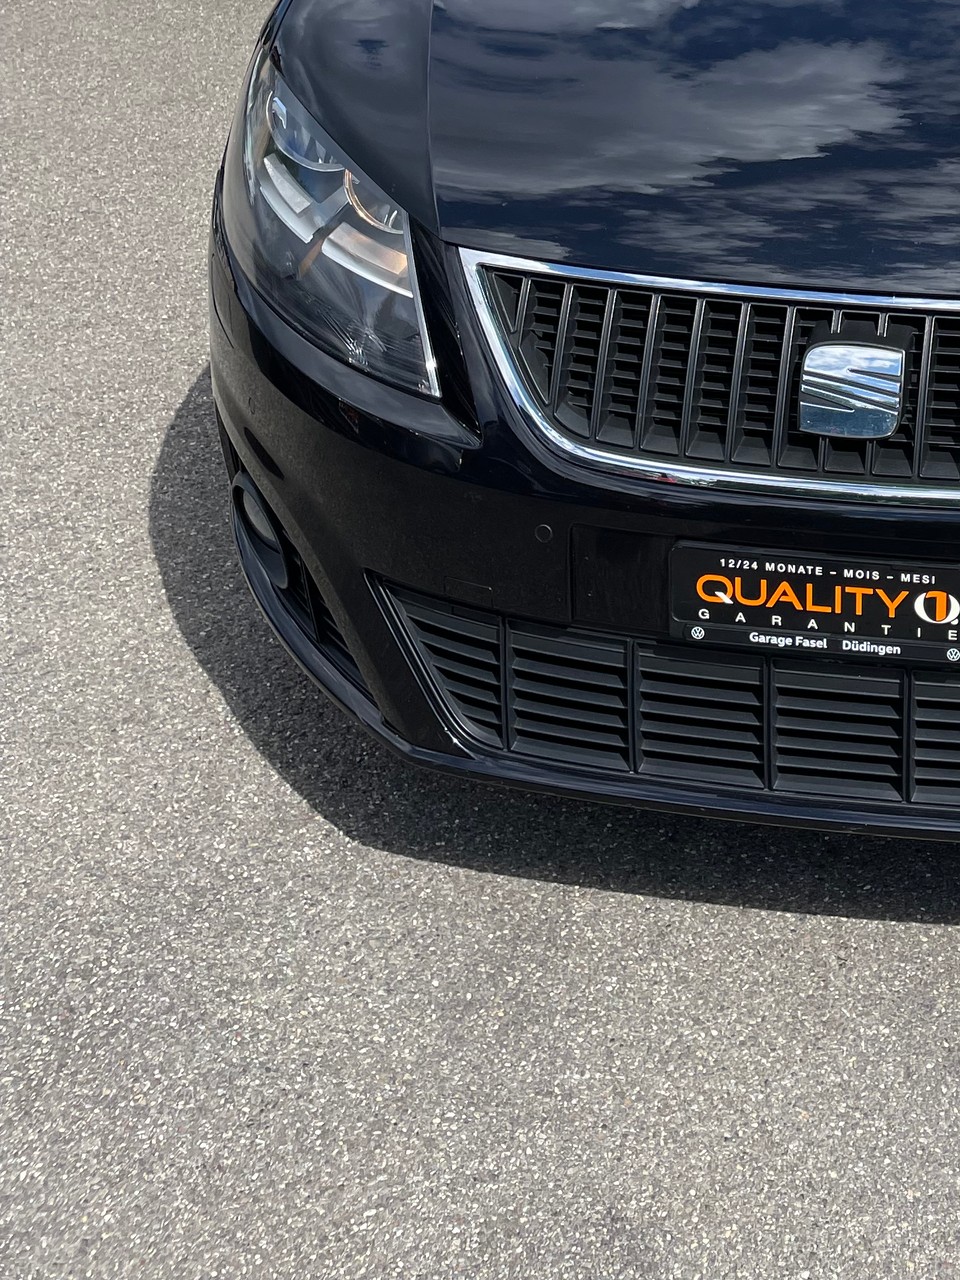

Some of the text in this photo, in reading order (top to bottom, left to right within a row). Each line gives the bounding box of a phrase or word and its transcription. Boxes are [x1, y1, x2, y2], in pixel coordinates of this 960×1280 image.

[719, 558, 759, 570] 12/24
[765, 562, 823, 576] MONATE
[843, 569, 880, 580] MOIS
[900, 573, 936, 585] MESI
[696, 574, 910, 618] QUALITY
[698, 608, 958, 641] GARANTIE
[749, 632, 901, 656] Garage Fasel Düdingen
